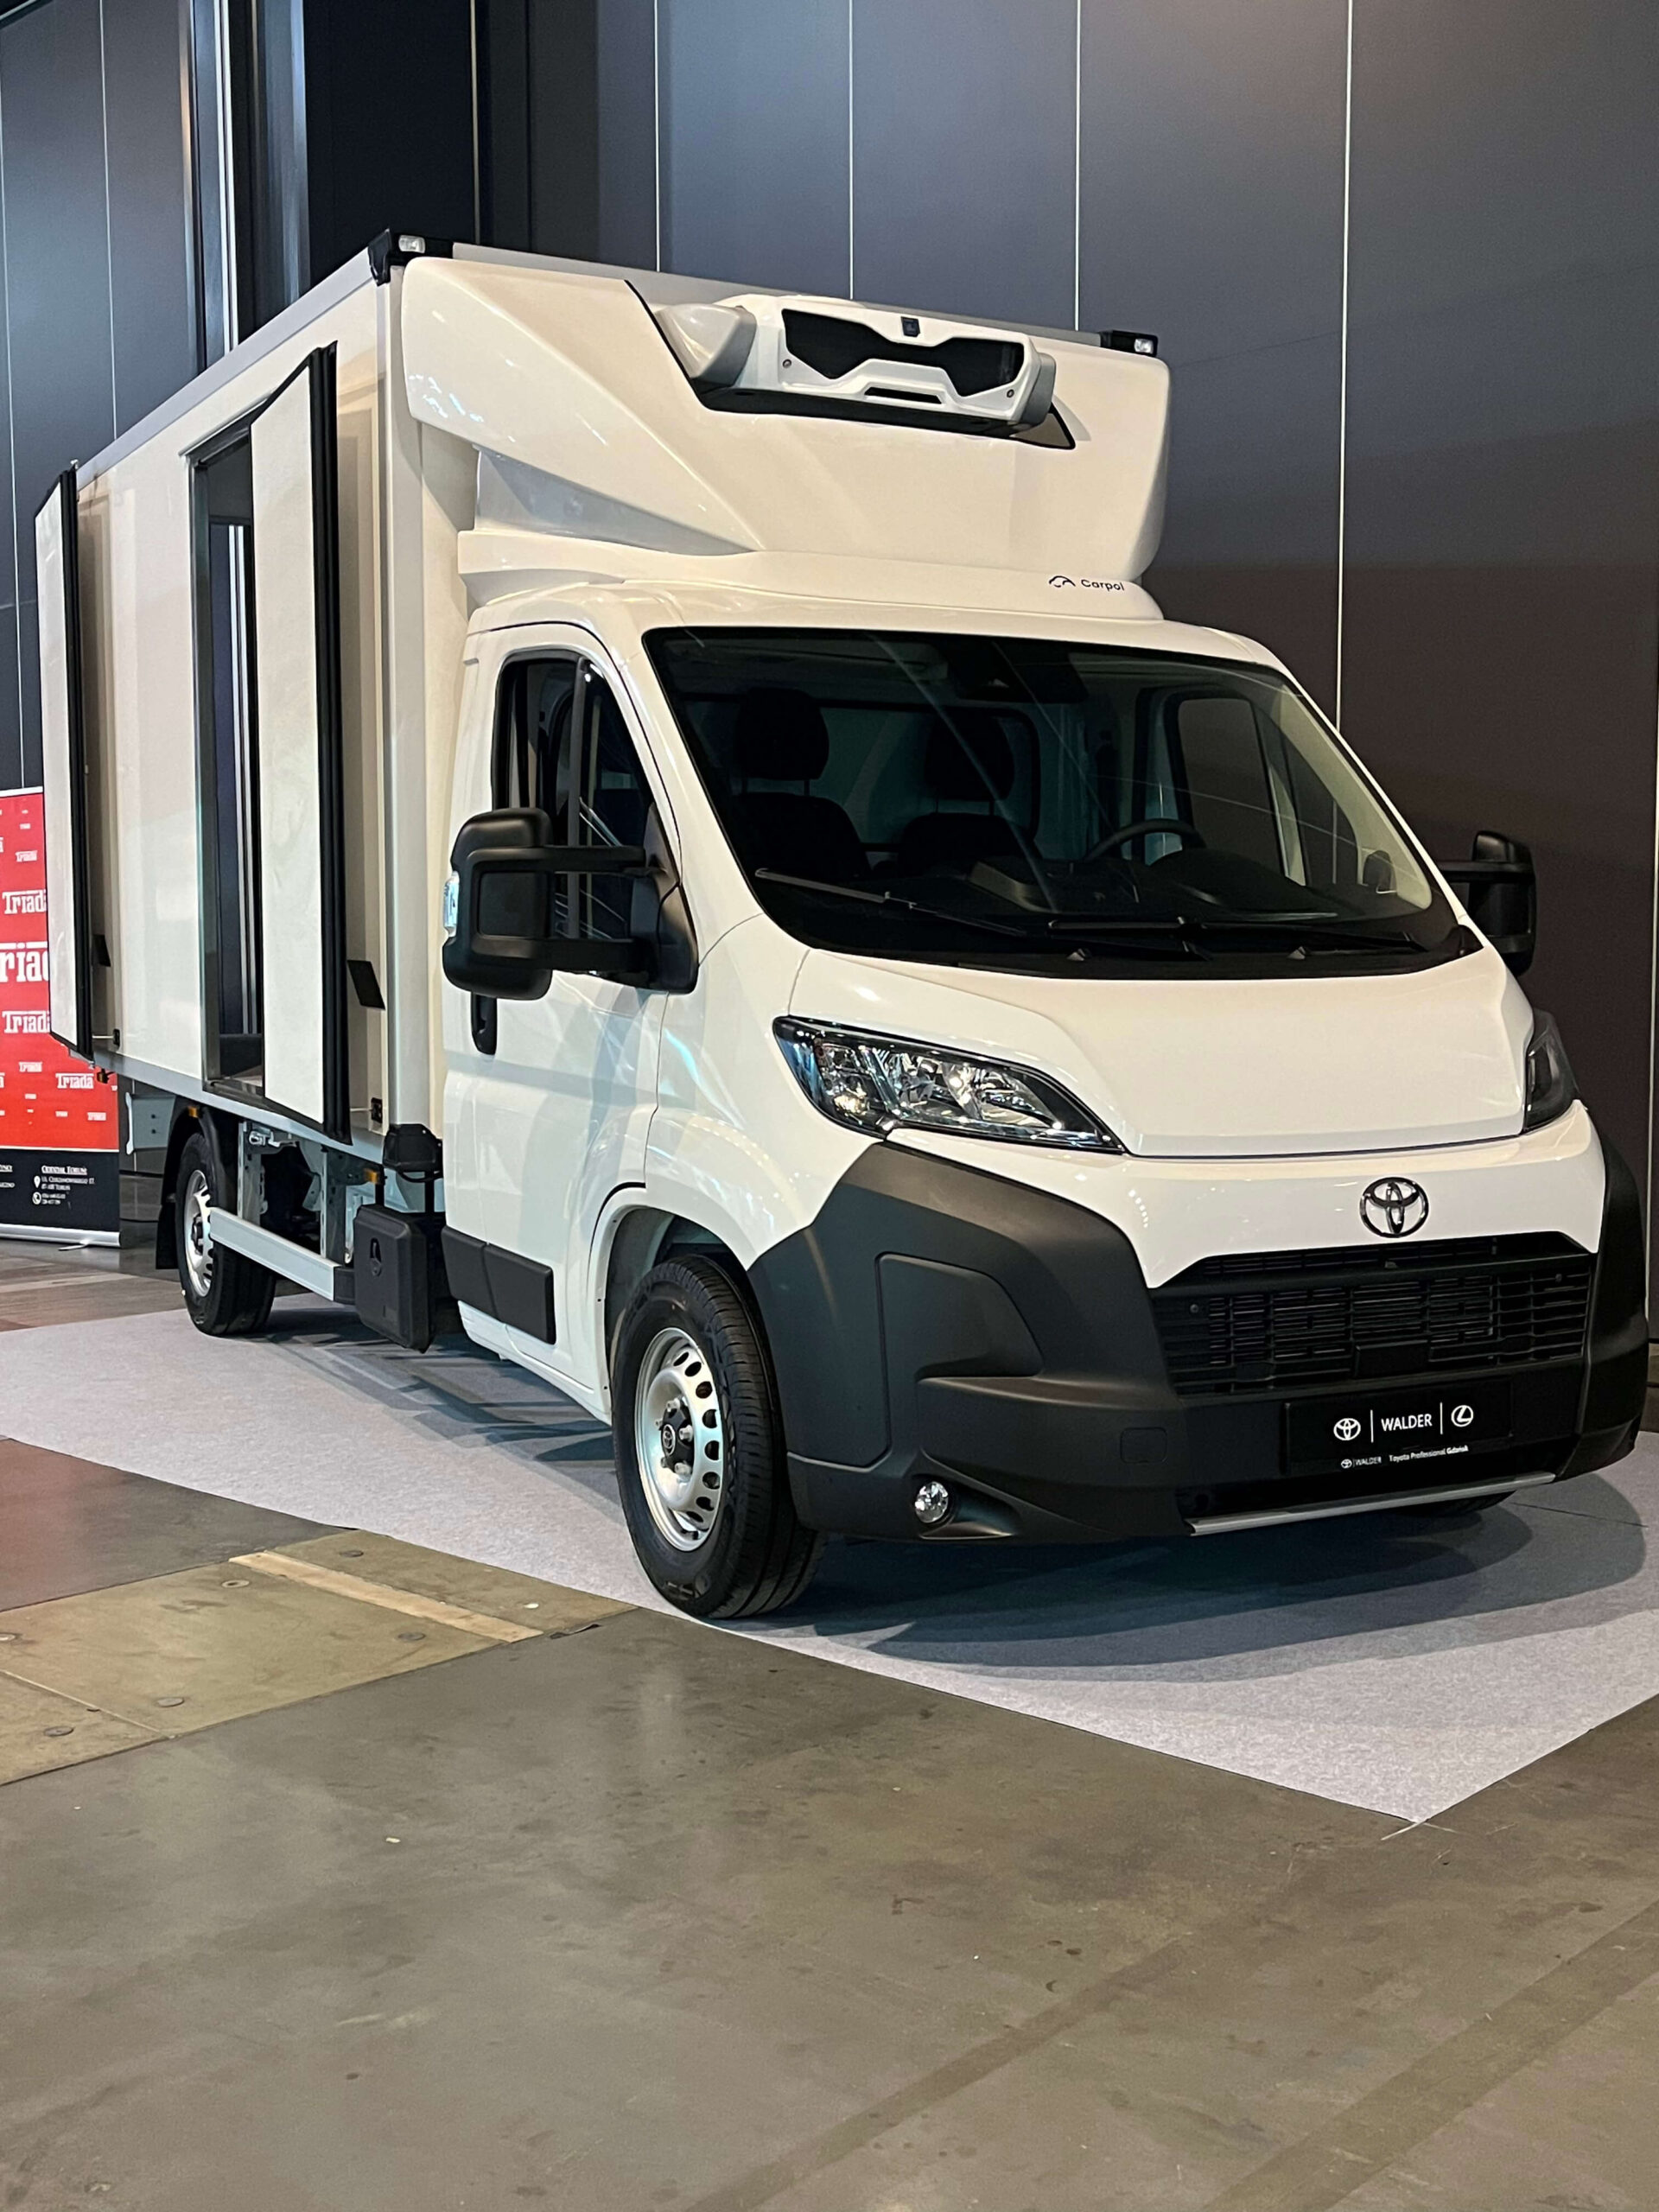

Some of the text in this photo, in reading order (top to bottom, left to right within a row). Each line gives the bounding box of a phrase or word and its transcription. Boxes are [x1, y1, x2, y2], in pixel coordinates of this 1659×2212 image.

[1080, 578, 1125, 592] Carpol
[2, 889, 47, 914] Triad
[55, 1072, 94, 1089] Triada
[1381, 1414, 1433, 1431] WALDER
[1355, 1456, 1382, 1466] WALDER
[1389, 1454, 1410, 1463] Toyota
[1410, 1448, 1446, 1459] Professional
